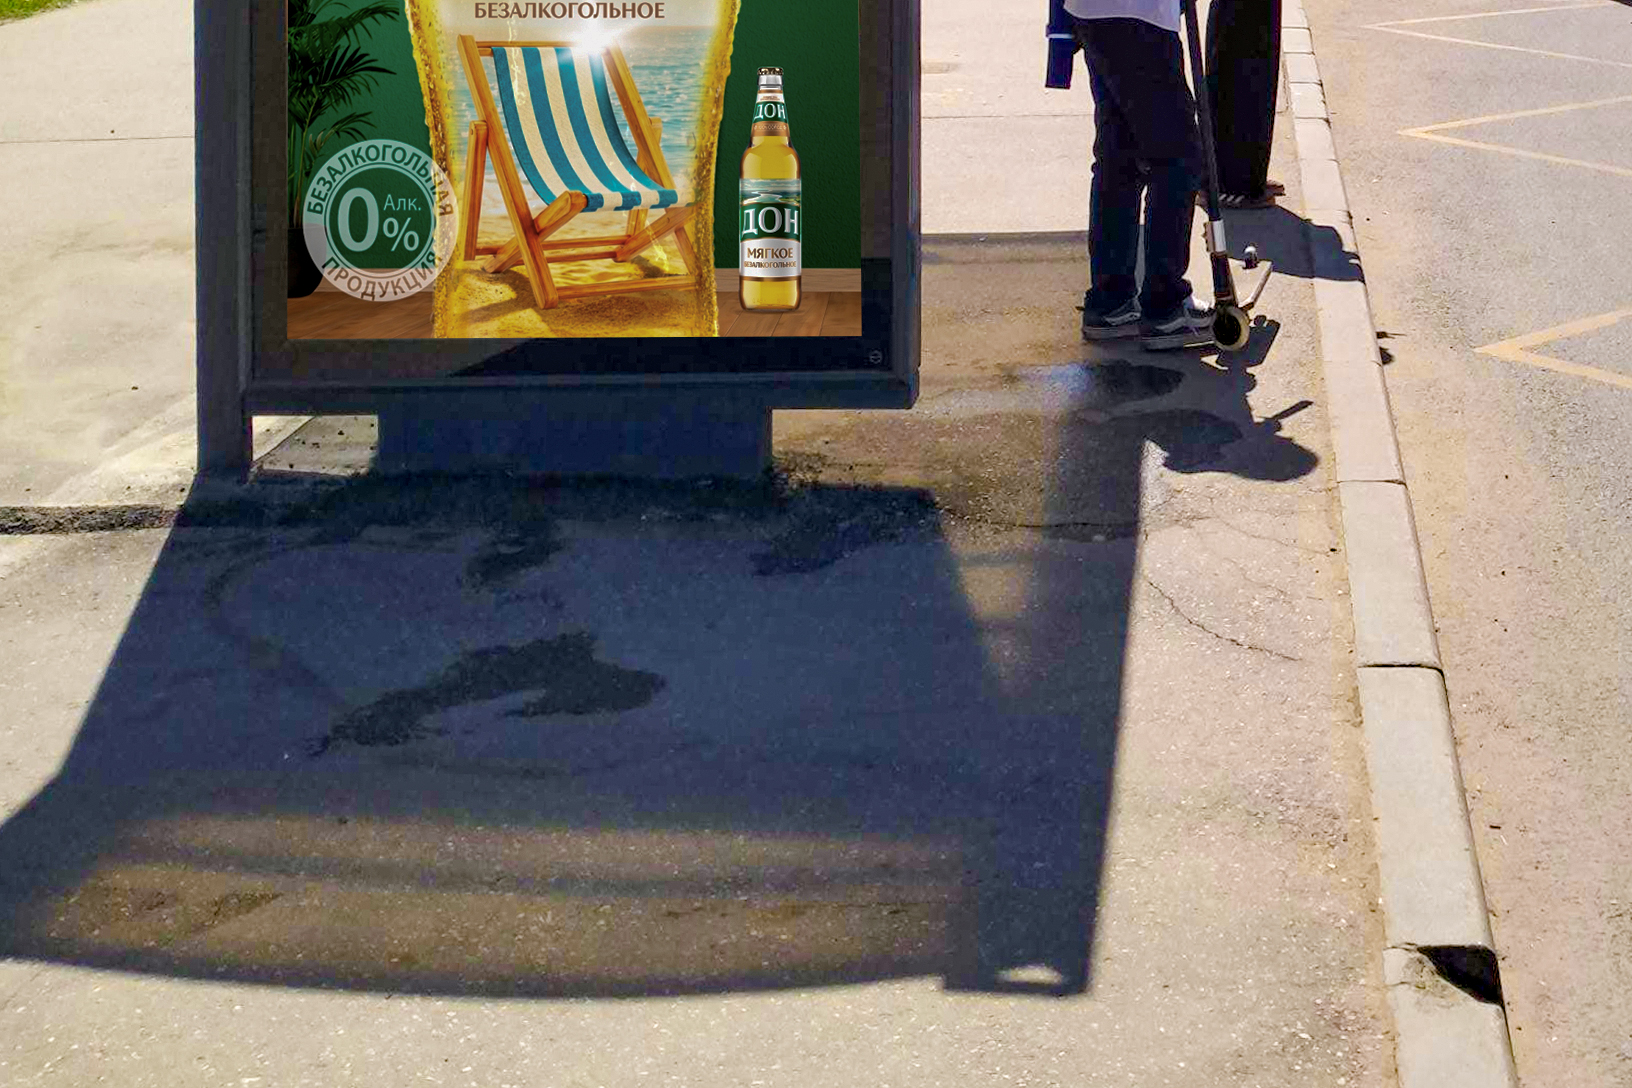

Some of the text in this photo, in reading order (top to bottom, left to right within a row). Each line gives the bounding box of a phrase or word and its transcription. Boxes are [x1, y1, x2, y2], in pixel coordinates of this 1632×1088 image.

[474, 1, 666, 20] БЕЗАЛКОГОЛЬНОЕ
[754, 102, 786, 120] ДОН
[383, 194, 422, 211] Алк.
[742, 206, 799, 237] ДОН
[747, 247, 793, 259] МЯГКОЕ
[743, 260, 797, 269] БЕЗАЛКОГОЛЬНОЕ
[322, 251, 442, 302] ПРОДУКЦИЯ
